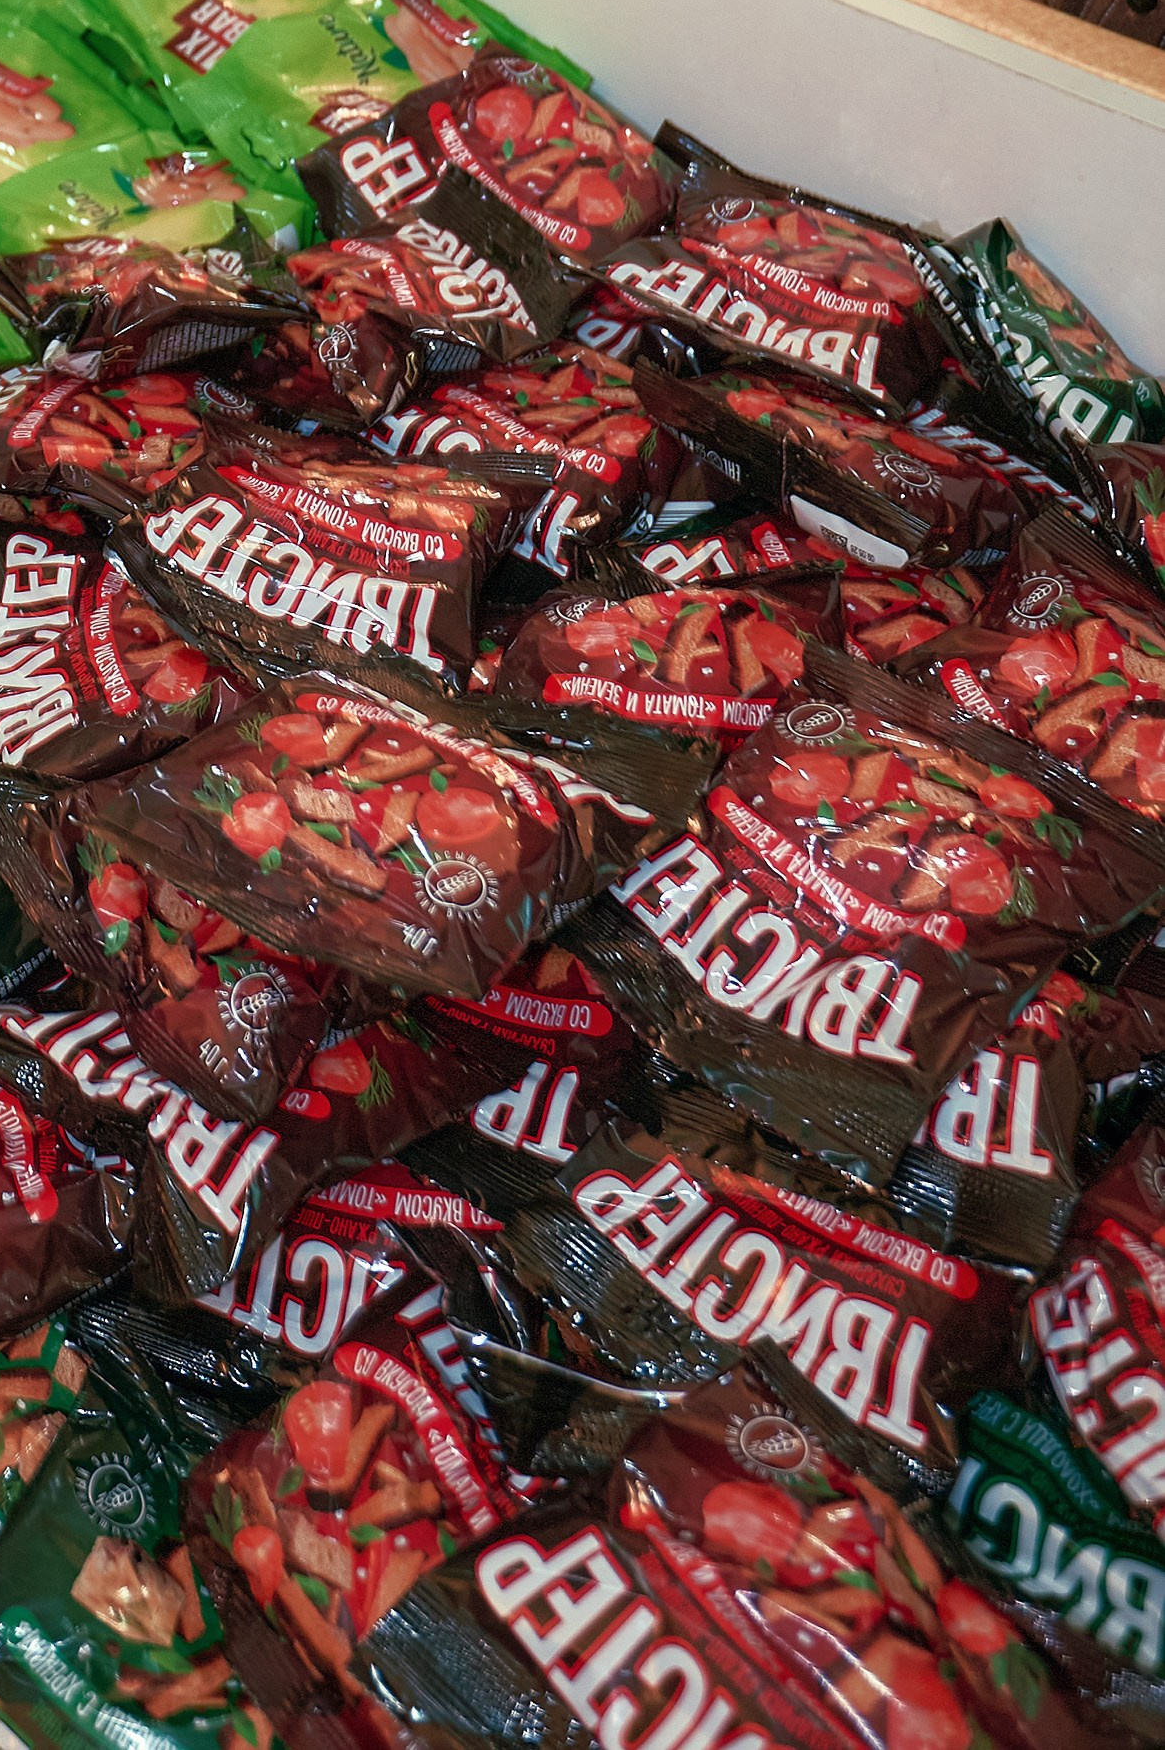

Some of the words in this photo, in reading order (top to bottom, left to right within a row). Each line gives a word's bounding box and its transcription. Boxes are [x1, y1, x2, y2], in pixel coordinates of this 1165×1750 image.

[318, 14, 381, 86] Nature
[389, 265, 417, 309] «ТОМАТ
[753, 254, 811, 295] «ТОМАТА
[814, 286, 868, 314] ВКУСОМ
[873, 301, 890, 316] СО
[295, 489, 358, 531] «ТОМАТА
[362, 520, 420, 556] ВКУСОМ
[422, 534, 445, 559] СО
[144, 496, 444, 673] ТВИСТЕР
[316, 695, 338, 711] СО
[561, 676, 623, 699] ЗЕЛЕНИ»
[624, 691, 639, 712] И
[644, 693, 717, 720] «ТОМАТА
[725, 800, 778, 848] ЗЕЛЕНИ»
[786, 852, 861, 909] «ТОМАТА
[505, 991, 567, 1025] ВКУСОМ
[569, 1004, 591, 1029] СО
[394, 1191, 463, 1222] ВКУСОМ
[294, 1208, 379, 1243] РЖАНО-ПШЕ
[853, 1225, 925, 1272] ВКУСОМ
[932, 1258, 956, 1286] СО
[574, 1160, 932, 1451] ТВИСТЕР
[352, 1346, 380, 1377] СО
[373, 1357, 438, 1425] ВКУСОМ
